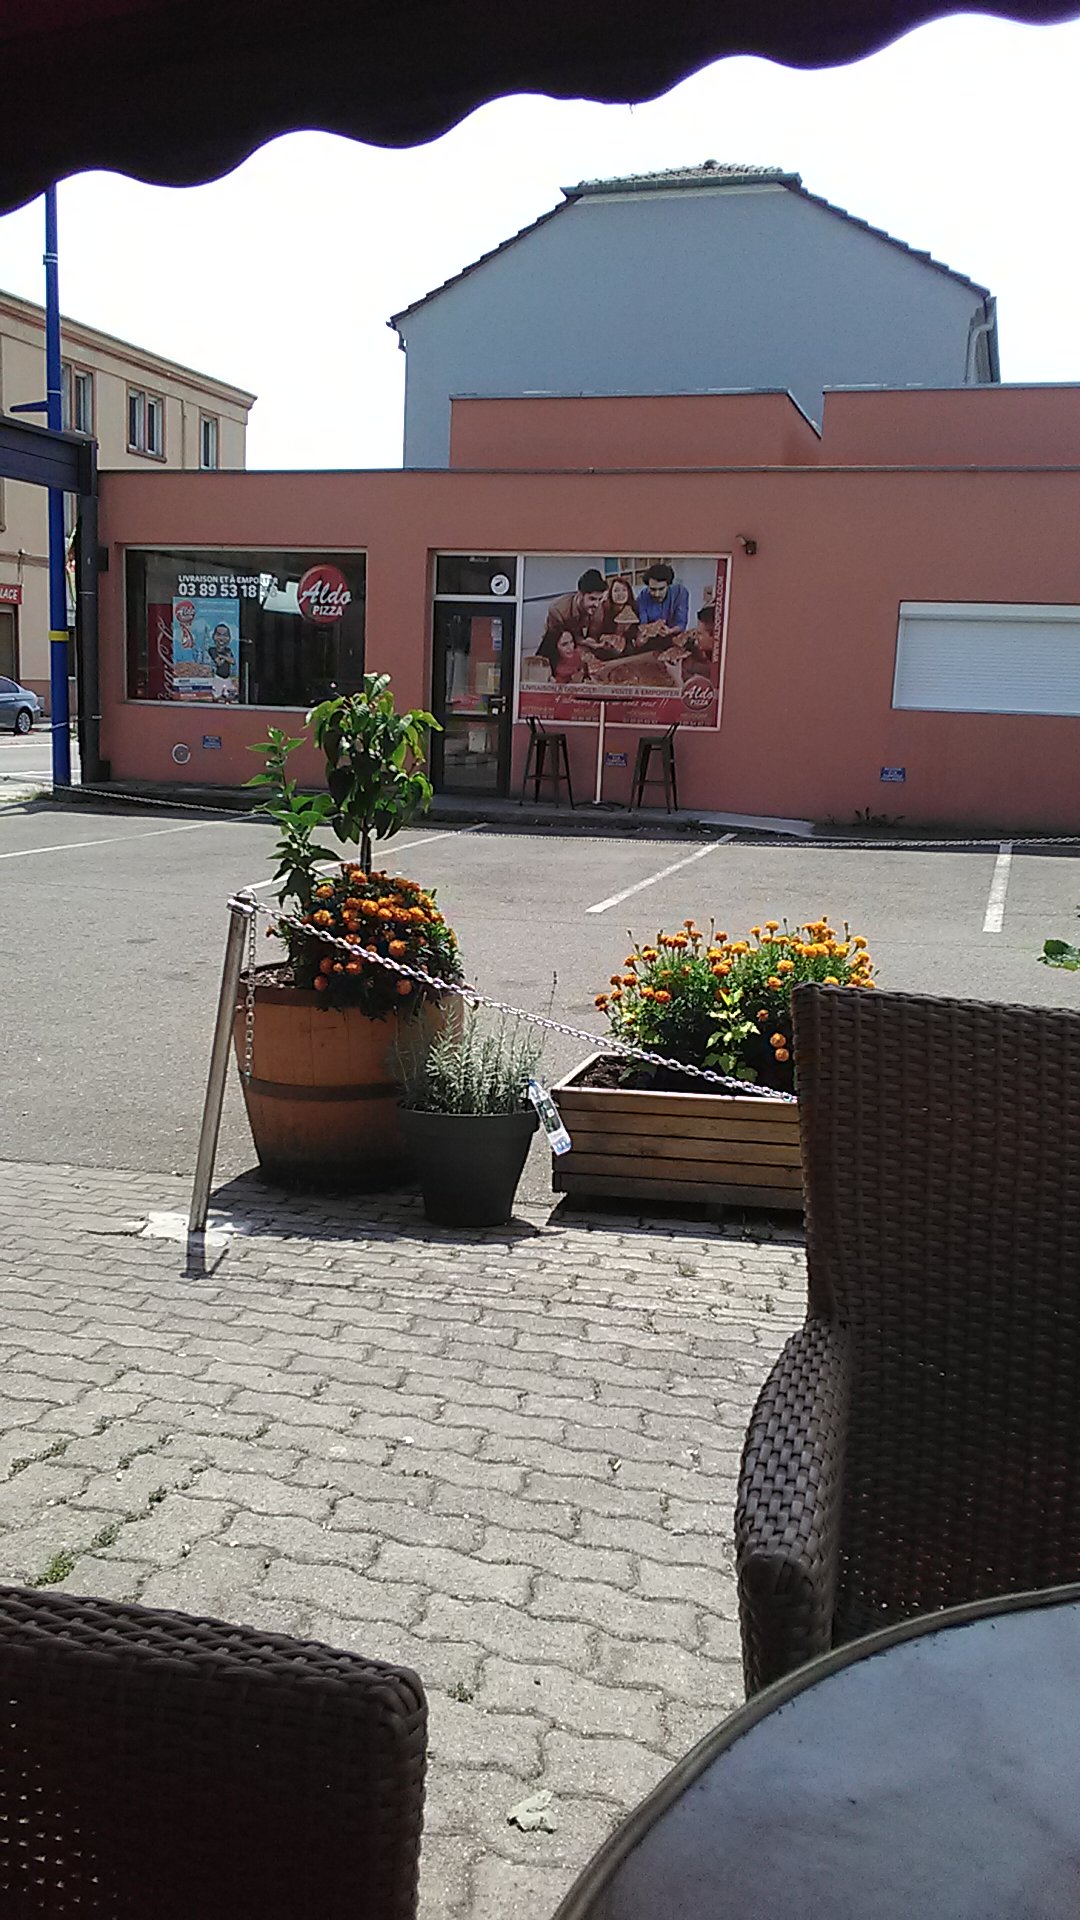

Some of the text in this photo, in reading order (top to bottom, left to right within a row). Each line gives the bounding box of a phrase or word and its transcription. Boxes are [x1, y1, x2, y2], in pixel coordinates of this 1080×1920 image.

[178, 574, 219, 584] LIVRAISON
[219, 575, 230, 584] ET
[178, 583, 196, 597] 03
[199, 583, 217, 597] 89
[220, 584, 238, 598] 53
[240, 585, 257, 599] 18
[299, 579, 352, 605] Aldo
[312, 604, 343, 617] PIZZA
[681, 685, 714, 700] Aldo
